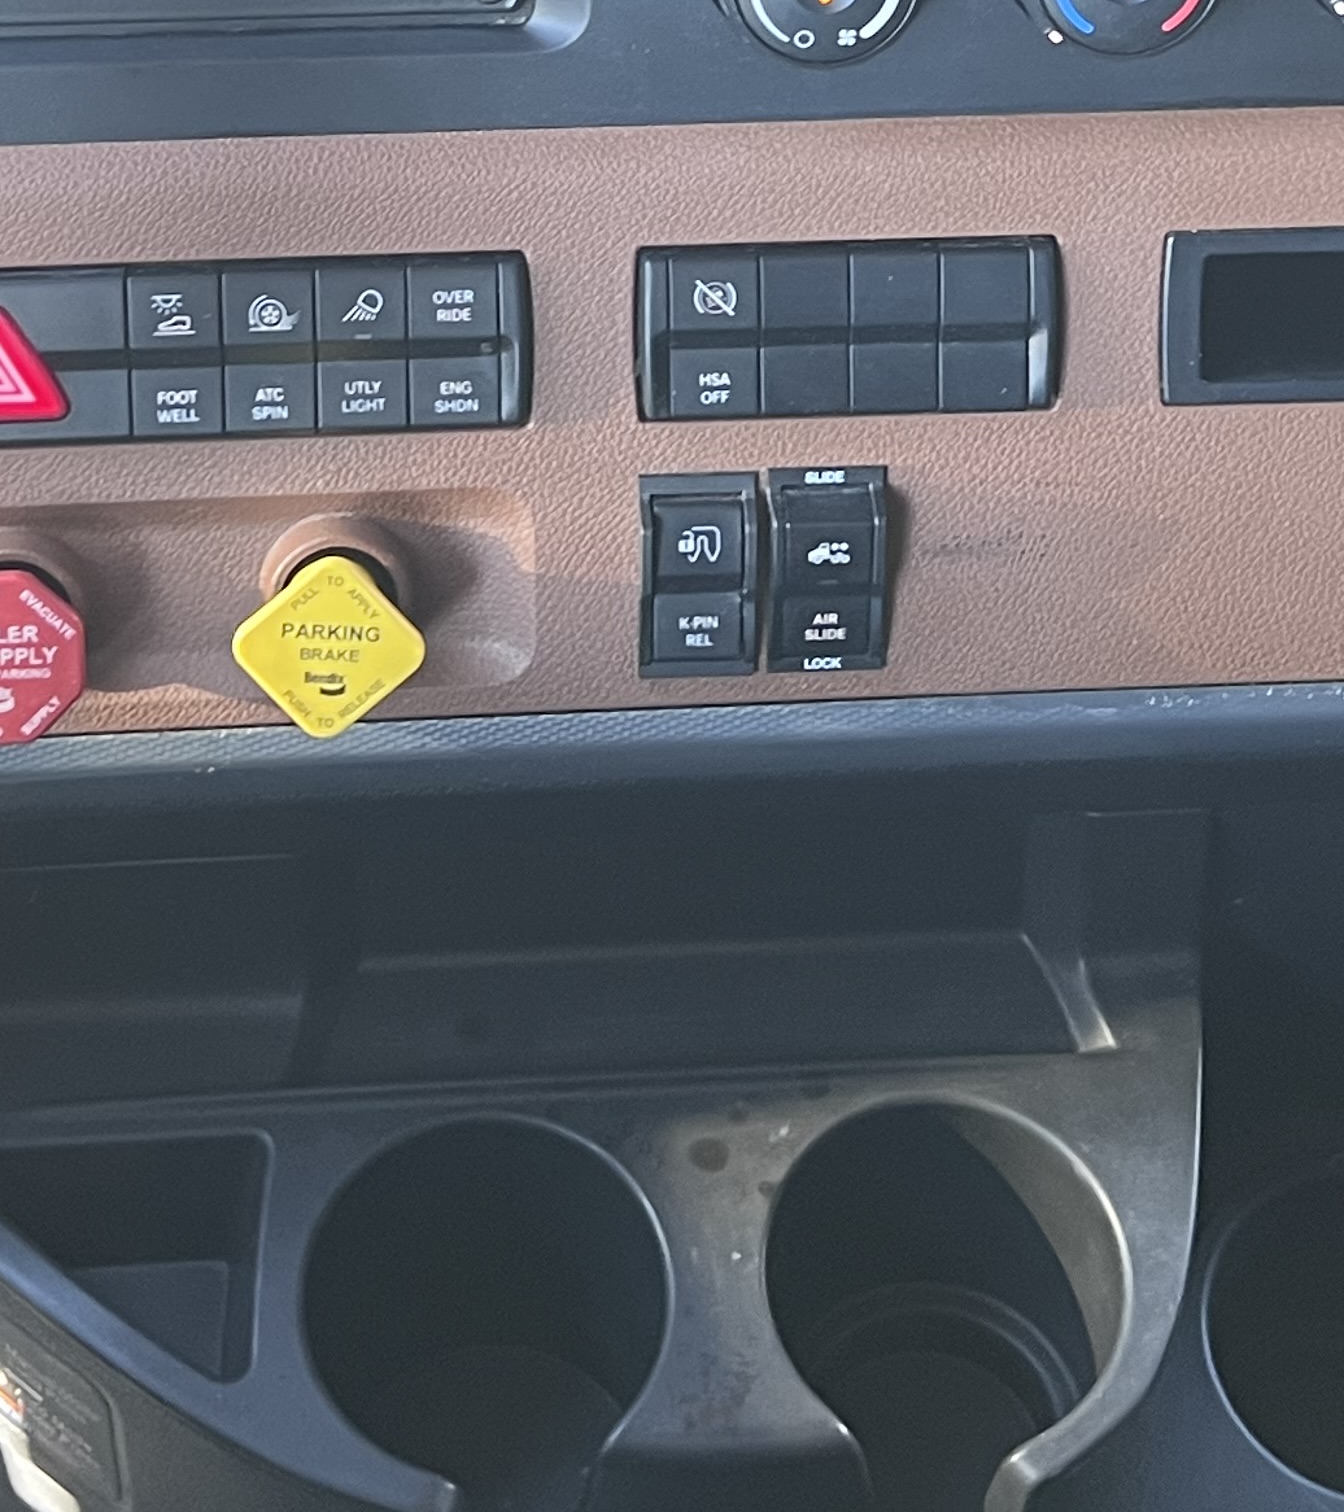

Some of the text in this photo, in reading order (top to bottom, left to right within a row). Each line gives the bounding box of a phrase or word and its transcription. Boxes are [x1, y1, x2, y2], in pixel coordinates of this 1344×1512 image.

[431, 290, 474, 306] OVER
[436, 307, 472, 323] RIDE
[344, 380, 382, 396] UTLY
[439, 380, 472, 396] ENG
[698, 372, 731, 388] HSA
[156, 389, 197, 406] FOOT
[254, 387, 285, 404] ATC
[700, 389, 731, 405] OFF
[252, 405, 289, 421] SPIN
[341, 397, 387, 414] LIGHT
[434, 397, 479, 414] SHDN
[157, 406, 200, 424] WELL
[804, 470, 845, 485] SLIDE
[290, 575, 381, 620] PULL TO APPLY
[18, 589, 78, 641] EVACUATE
[812, 611, 840, 627] AIR
[280, 622, 381, 644] PARKING
[685, 632, 714, 647] REL
[804, 626, 847, 642] SLIDE
[299, 647, 361, 664] BRAKE
[803, 656, 843, 671] LOCK
[283, 679, 387, 728] PUSH TO RELEASE
